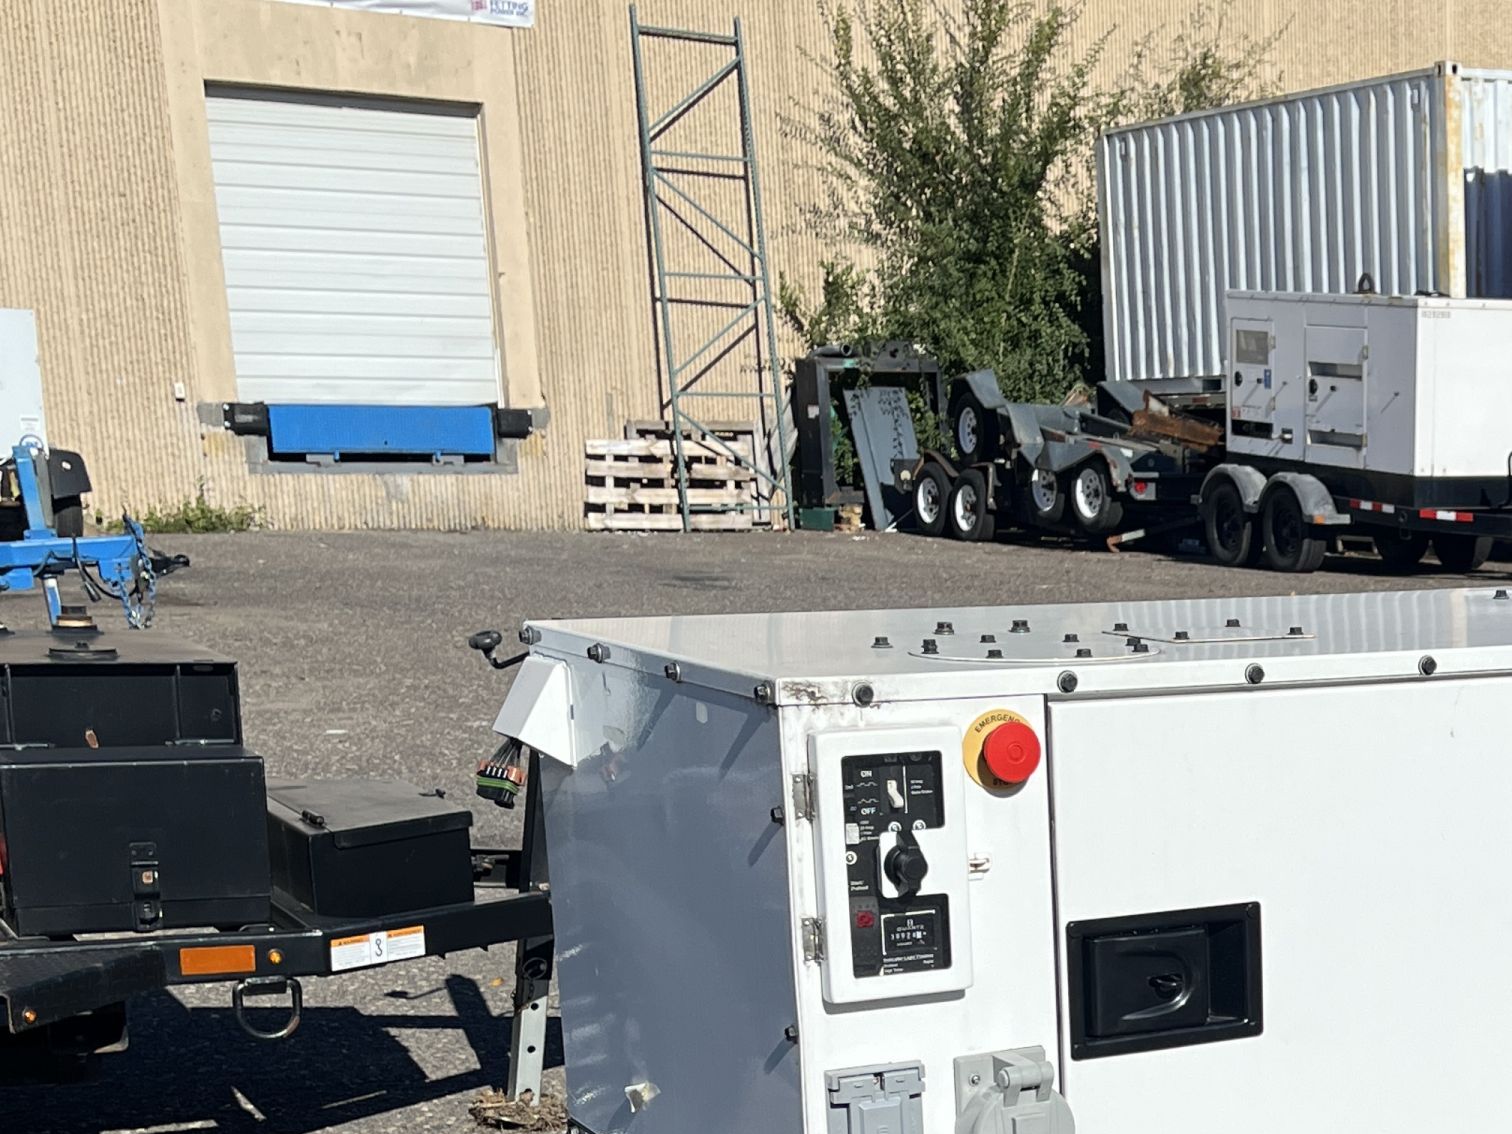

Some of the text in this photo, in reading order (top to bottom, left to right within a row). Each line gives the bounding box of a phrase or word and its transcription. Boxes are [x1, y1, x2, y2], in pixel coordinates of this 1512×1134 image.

[975, 714, 1021, 733] EMERGENC
[860, 770, 873, 778] ON
[860, 807, 876, 815] OFF
